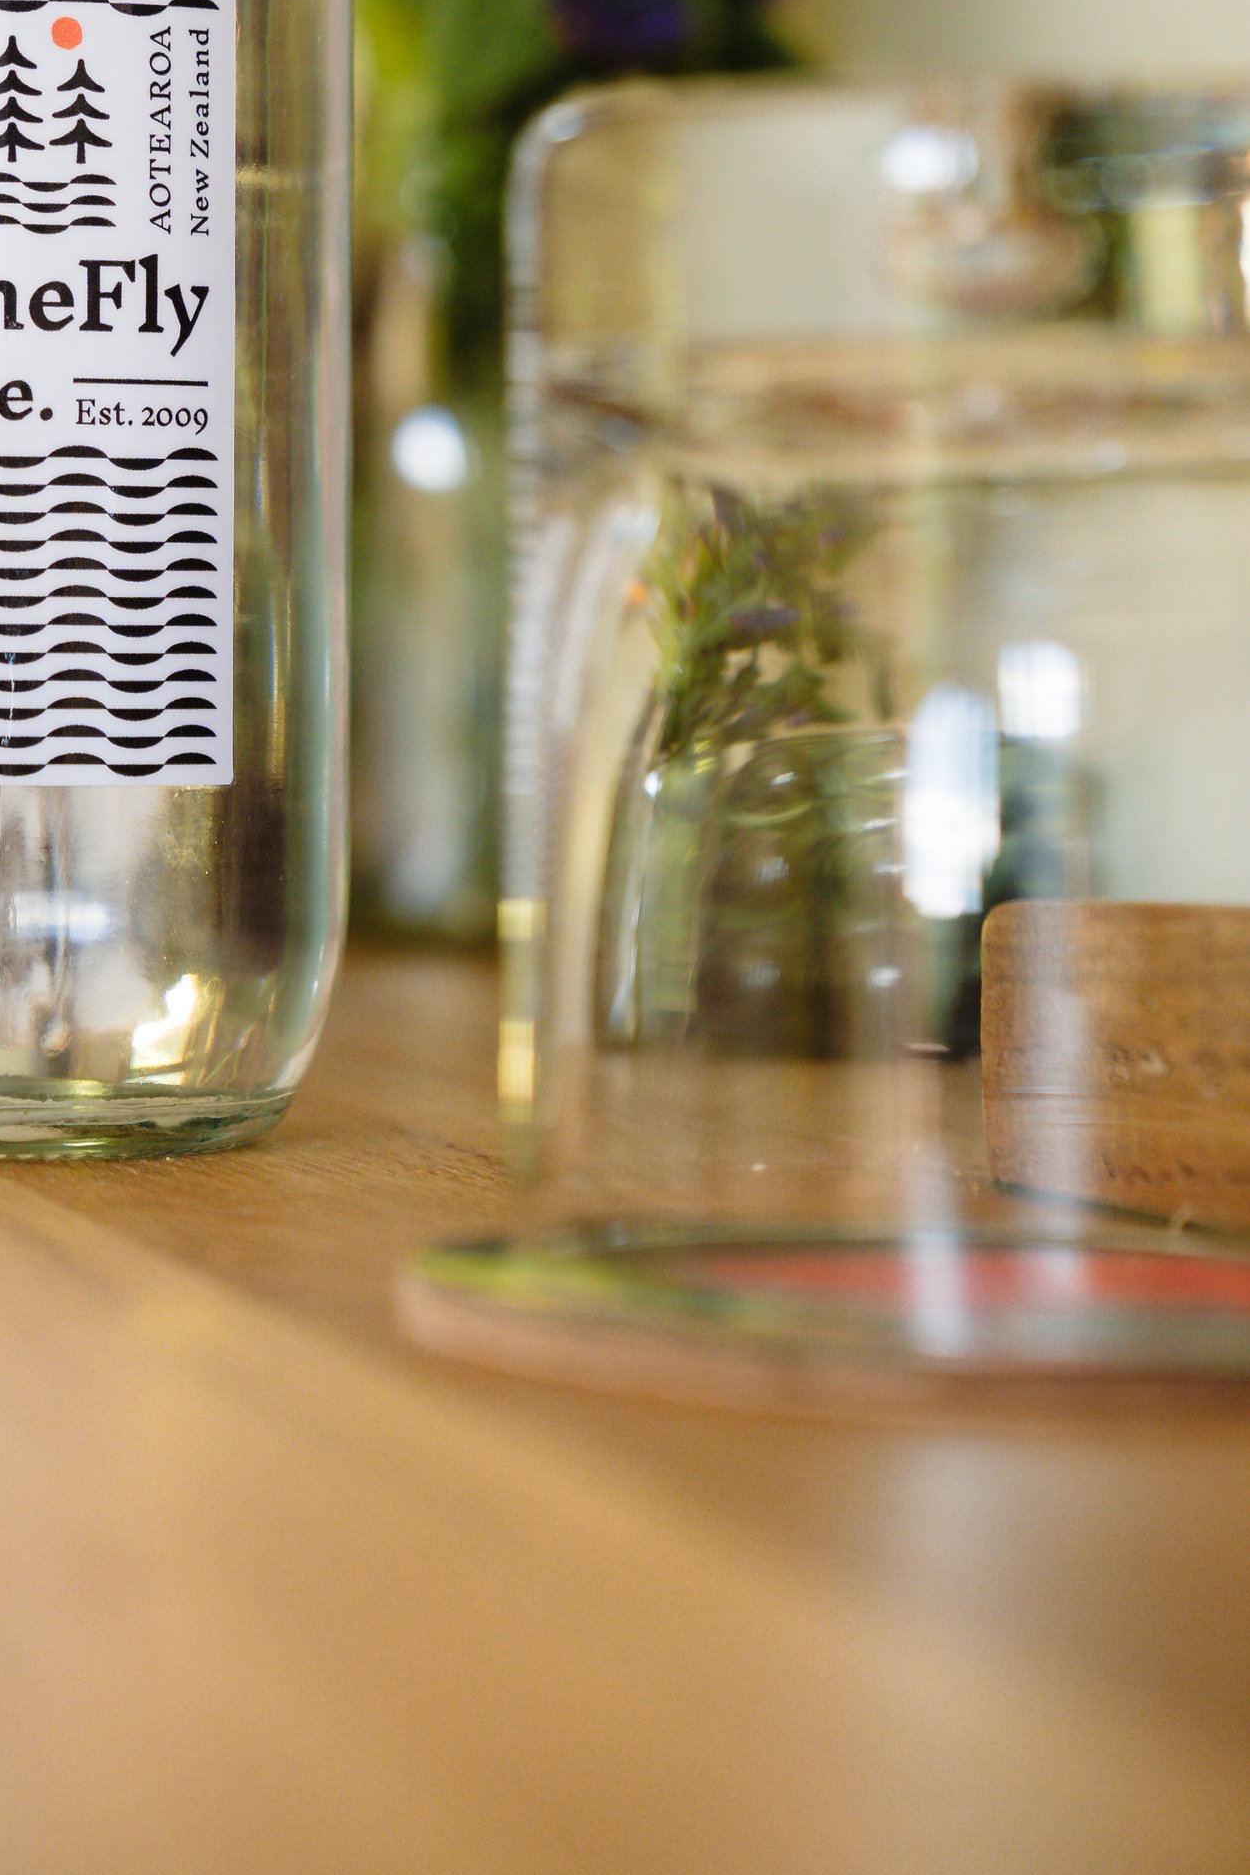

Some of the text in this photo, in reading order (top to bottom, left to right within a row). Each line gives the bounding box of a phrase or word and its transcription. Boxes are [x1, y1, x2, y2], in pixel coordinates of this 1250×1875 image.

[149, 25, 172, 235] AOTEAROA
[189, 27, 210, 237] New Zealand
[75, 398, 209, 435] Est. 2009
